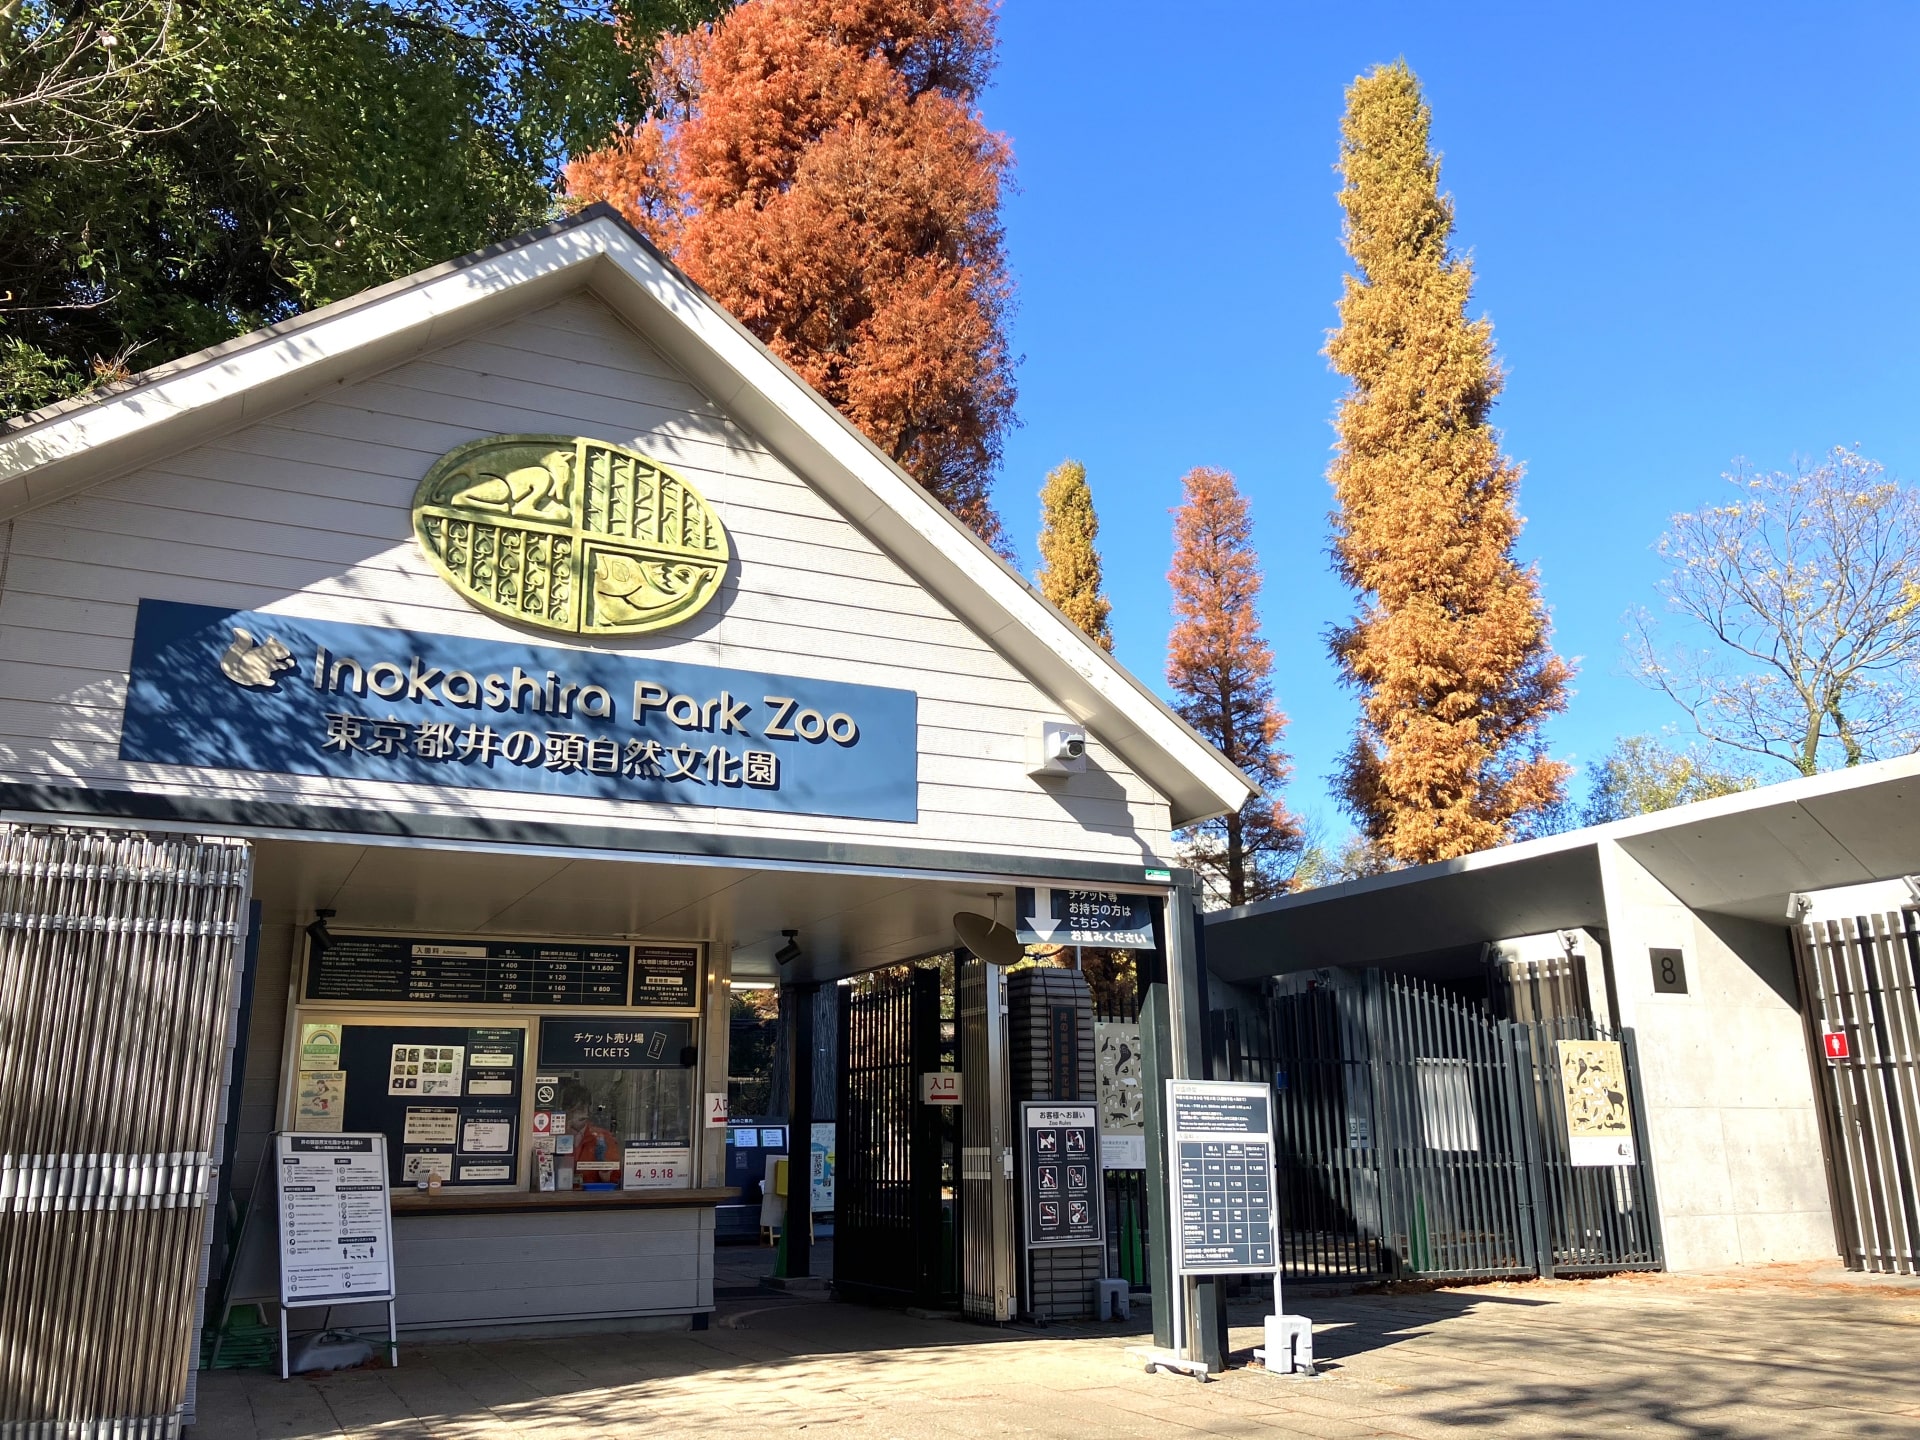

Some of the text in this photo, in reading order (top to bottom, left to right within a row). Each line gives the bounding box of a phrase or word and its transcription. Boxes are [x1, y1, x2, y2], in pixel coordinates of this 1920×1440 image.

[313, 645, 856, 743] Inokashira Park Zoo
[321, 713, 776, 786] 東京都井の頭自然文化園
[1069, 902, 1132, 917] お持ちの方は
[1070, 916, 1111, 929] こちらへ
[1070, 930, 1147, 943] お進みください
[1661, 957, 1676, 984] 8
[574, 1032, 644, 1044] チケット売り場
[584, 1048, 630, 1058] TICKETS
[930, 1077, 954, 1090] 入口
